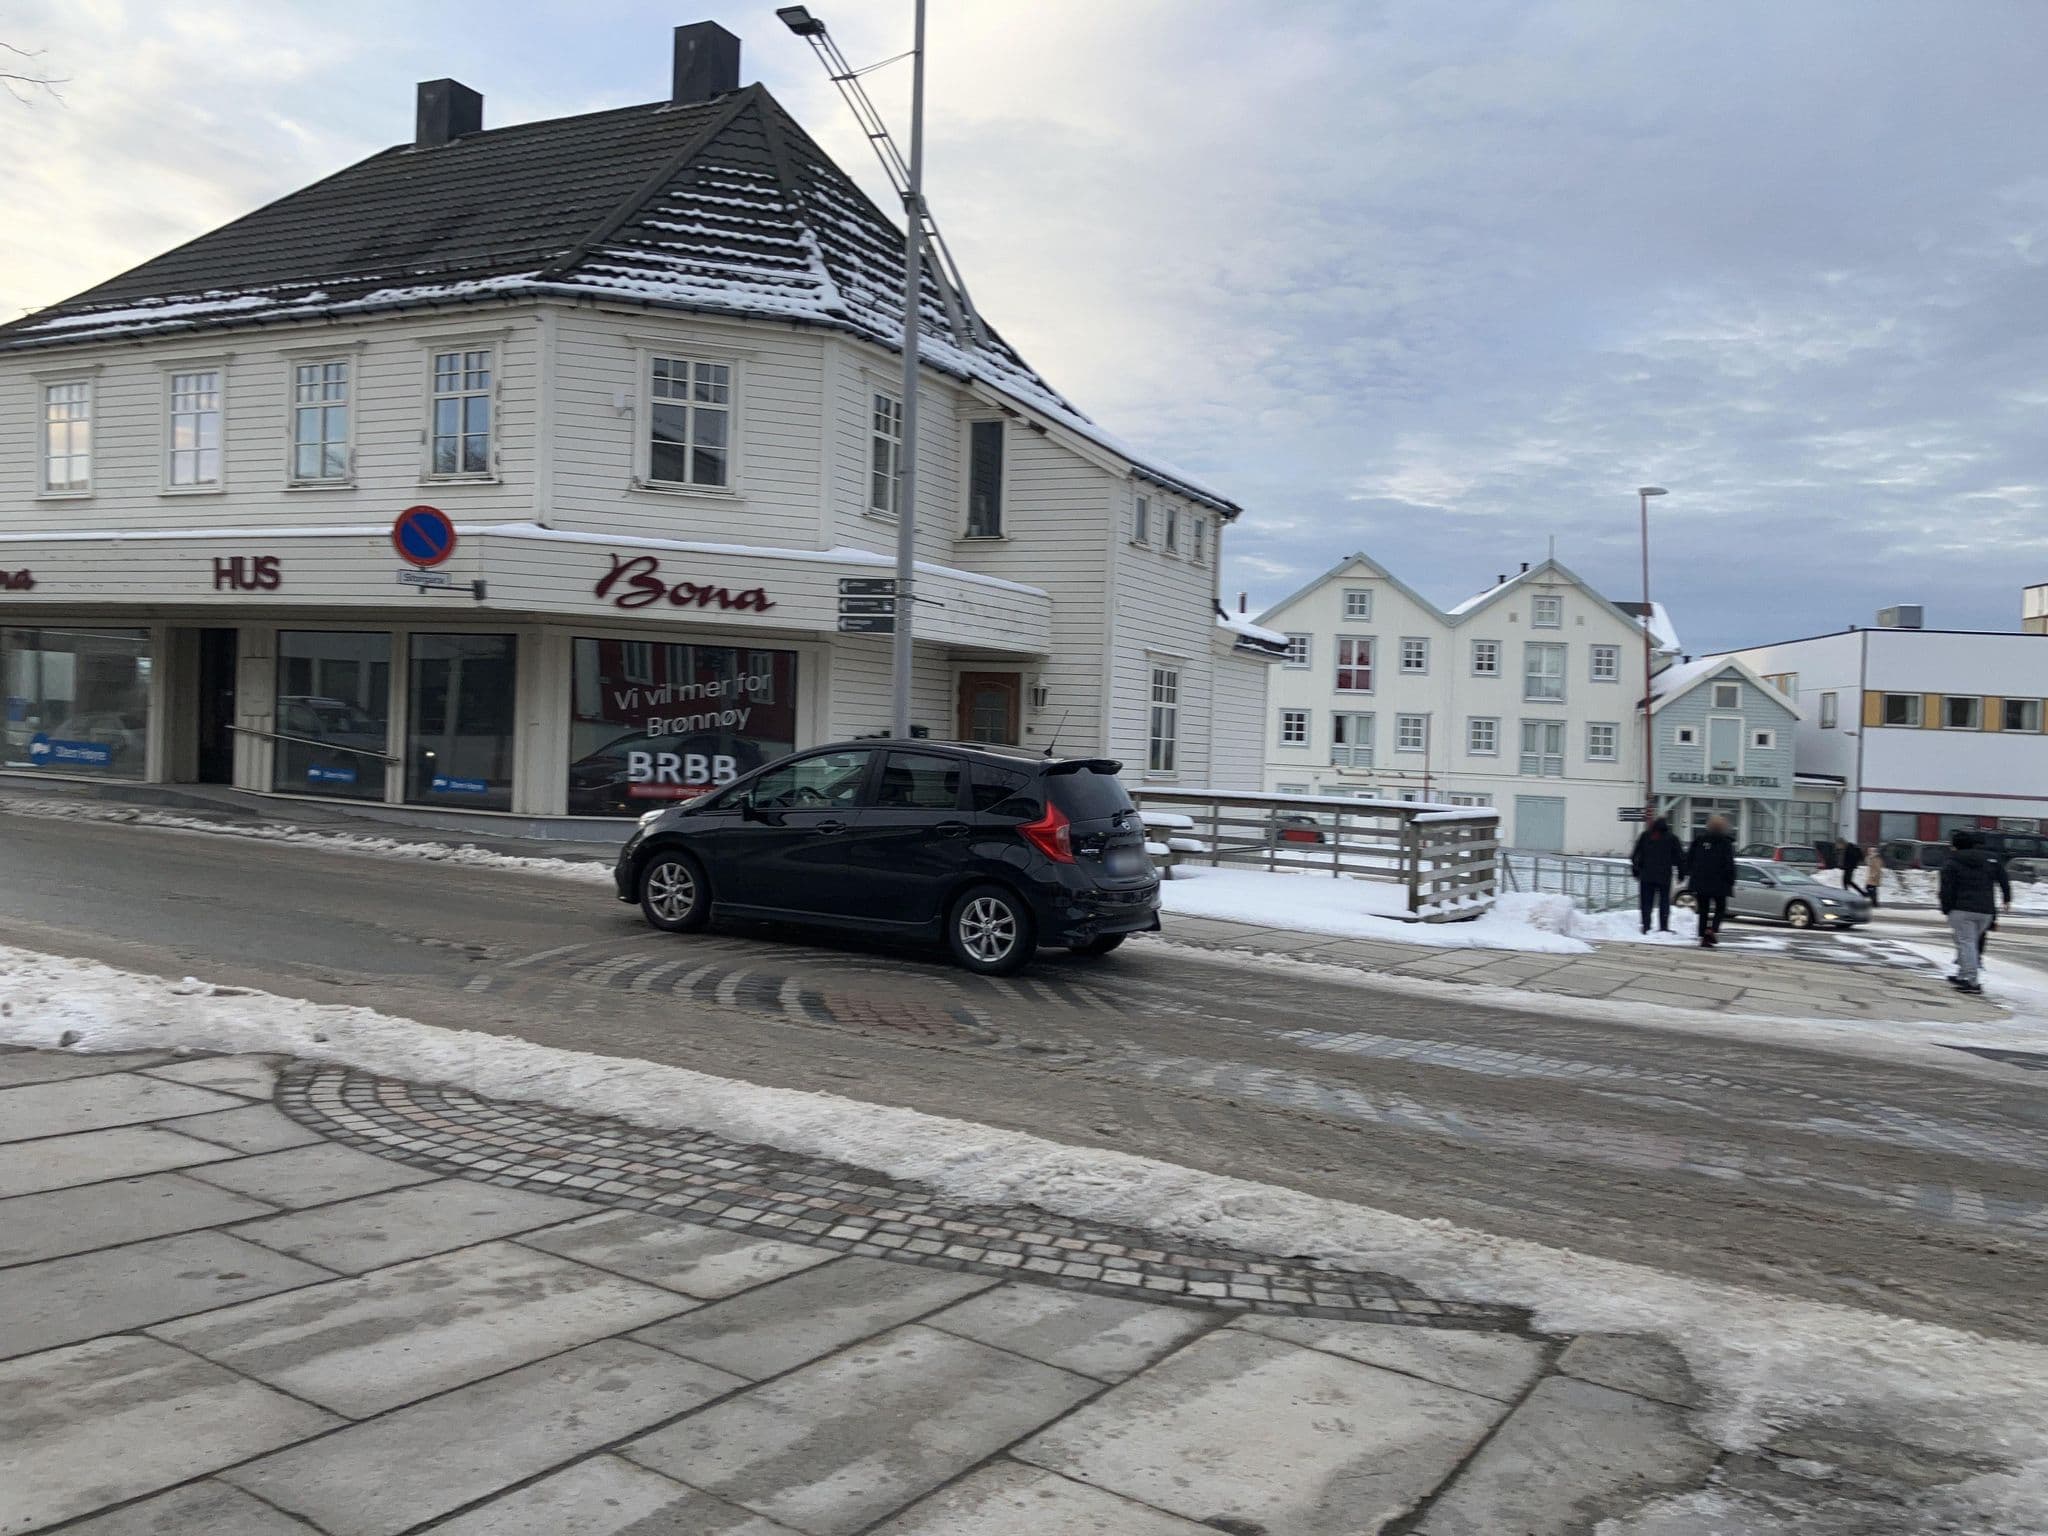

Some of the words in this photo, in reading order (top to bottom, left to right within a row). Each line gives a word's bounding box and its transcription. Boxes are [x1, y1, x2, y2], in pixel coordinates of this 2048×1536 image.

[213, 555, 282, 591] HUS
[595, 552, 776, 612] Bona
[614, 688, 638, 710] Vi
[645, 683, 671, 706] vil
[679, 679, 731, 701] mer
[736, 672, 772, 694] for
[647, 707, 752, 738] Brønnøy
[628, 751, 738, 785] BRBB
